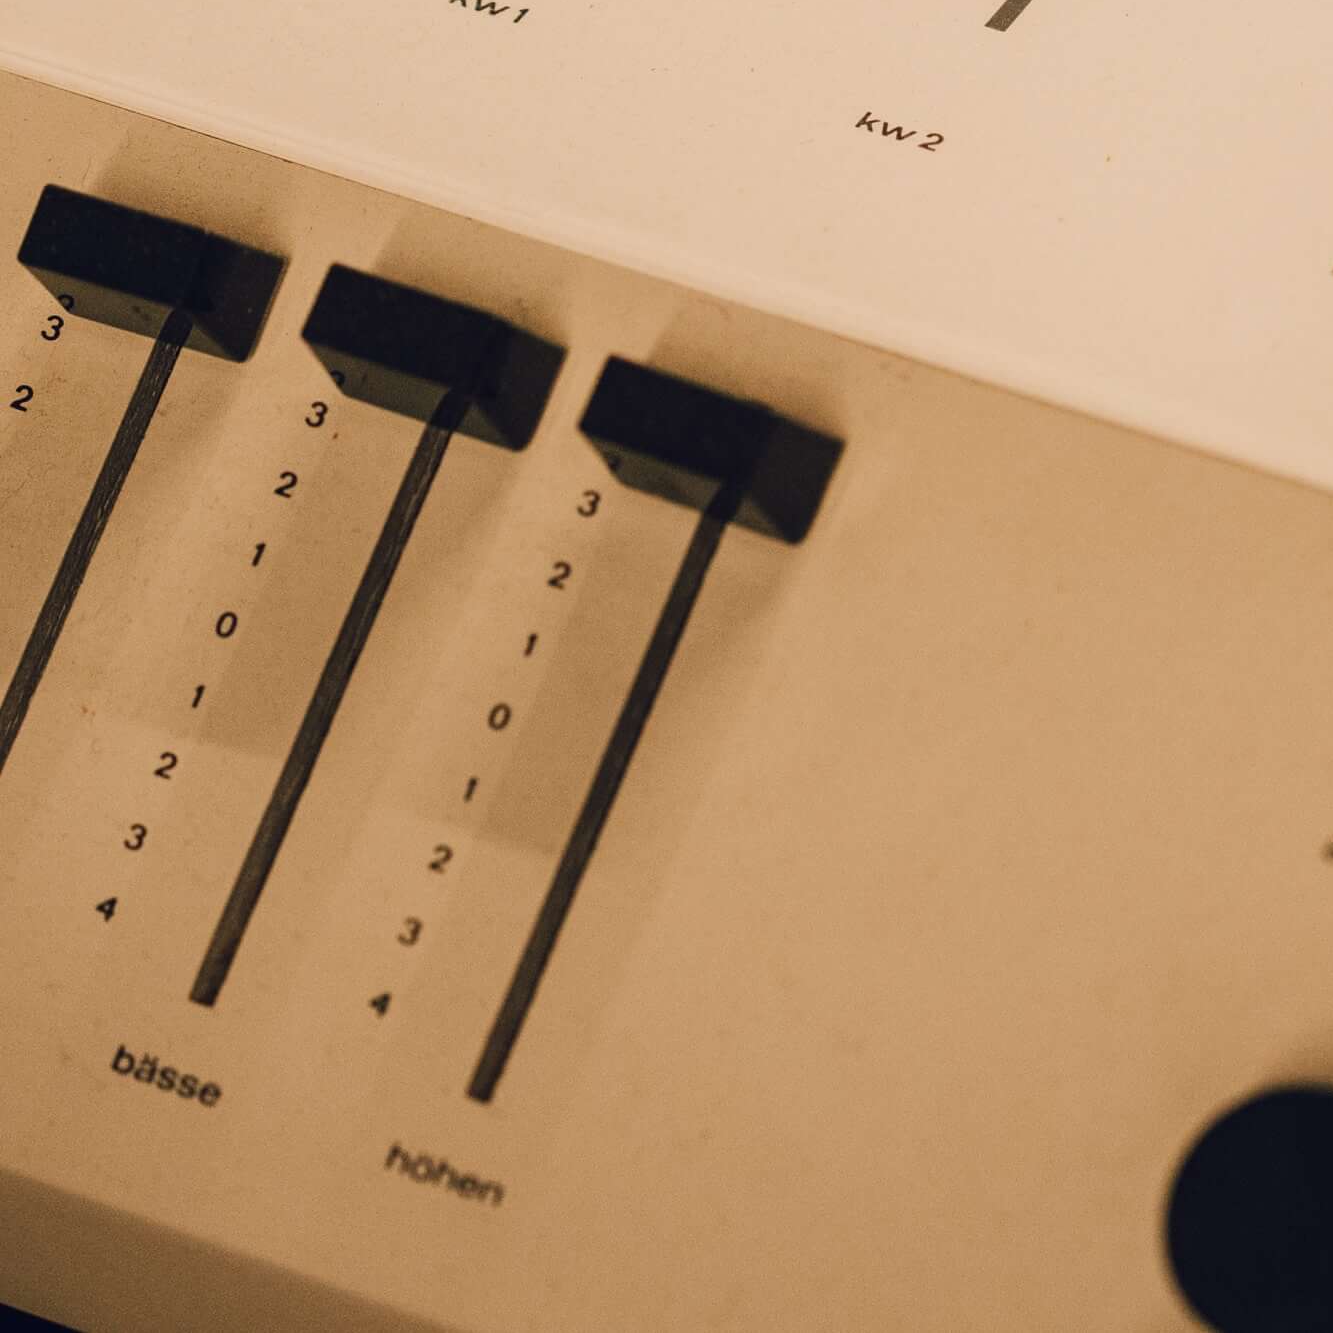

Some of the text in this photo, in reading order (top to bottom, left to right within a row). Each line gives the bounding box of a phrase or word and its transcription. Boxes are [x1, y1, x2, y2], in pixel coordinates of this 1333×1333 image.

[41, 314, 65, 341] 3
[10, 384, 34, 412] 2
[304, 401, 329, 429] 3
[273, 470, 298, 499] 2
[575, 488, 602, 518] 3
[251, 541, 267, 567] 1
[546, 560, 573, 591] 2
[214, 610, 239, 639] 0
[522, 632, 539, 659] 1
[191, 684, 207, 709] 1
[486, 701, 513, 732] 0
[153, 751, 179, 781] 2
[463, 775, 481, 803] 1
[123, 822, 148, 852] 3
[427, 842, 454, 876] 2
[95, 895, 119, 923] 4
[396, 915, 424, 949] 3
[368, 990, 393, 1019] 4
[109, 1042, 224, 1109] bässe
[383, 1138, 507, 1210] höhen
